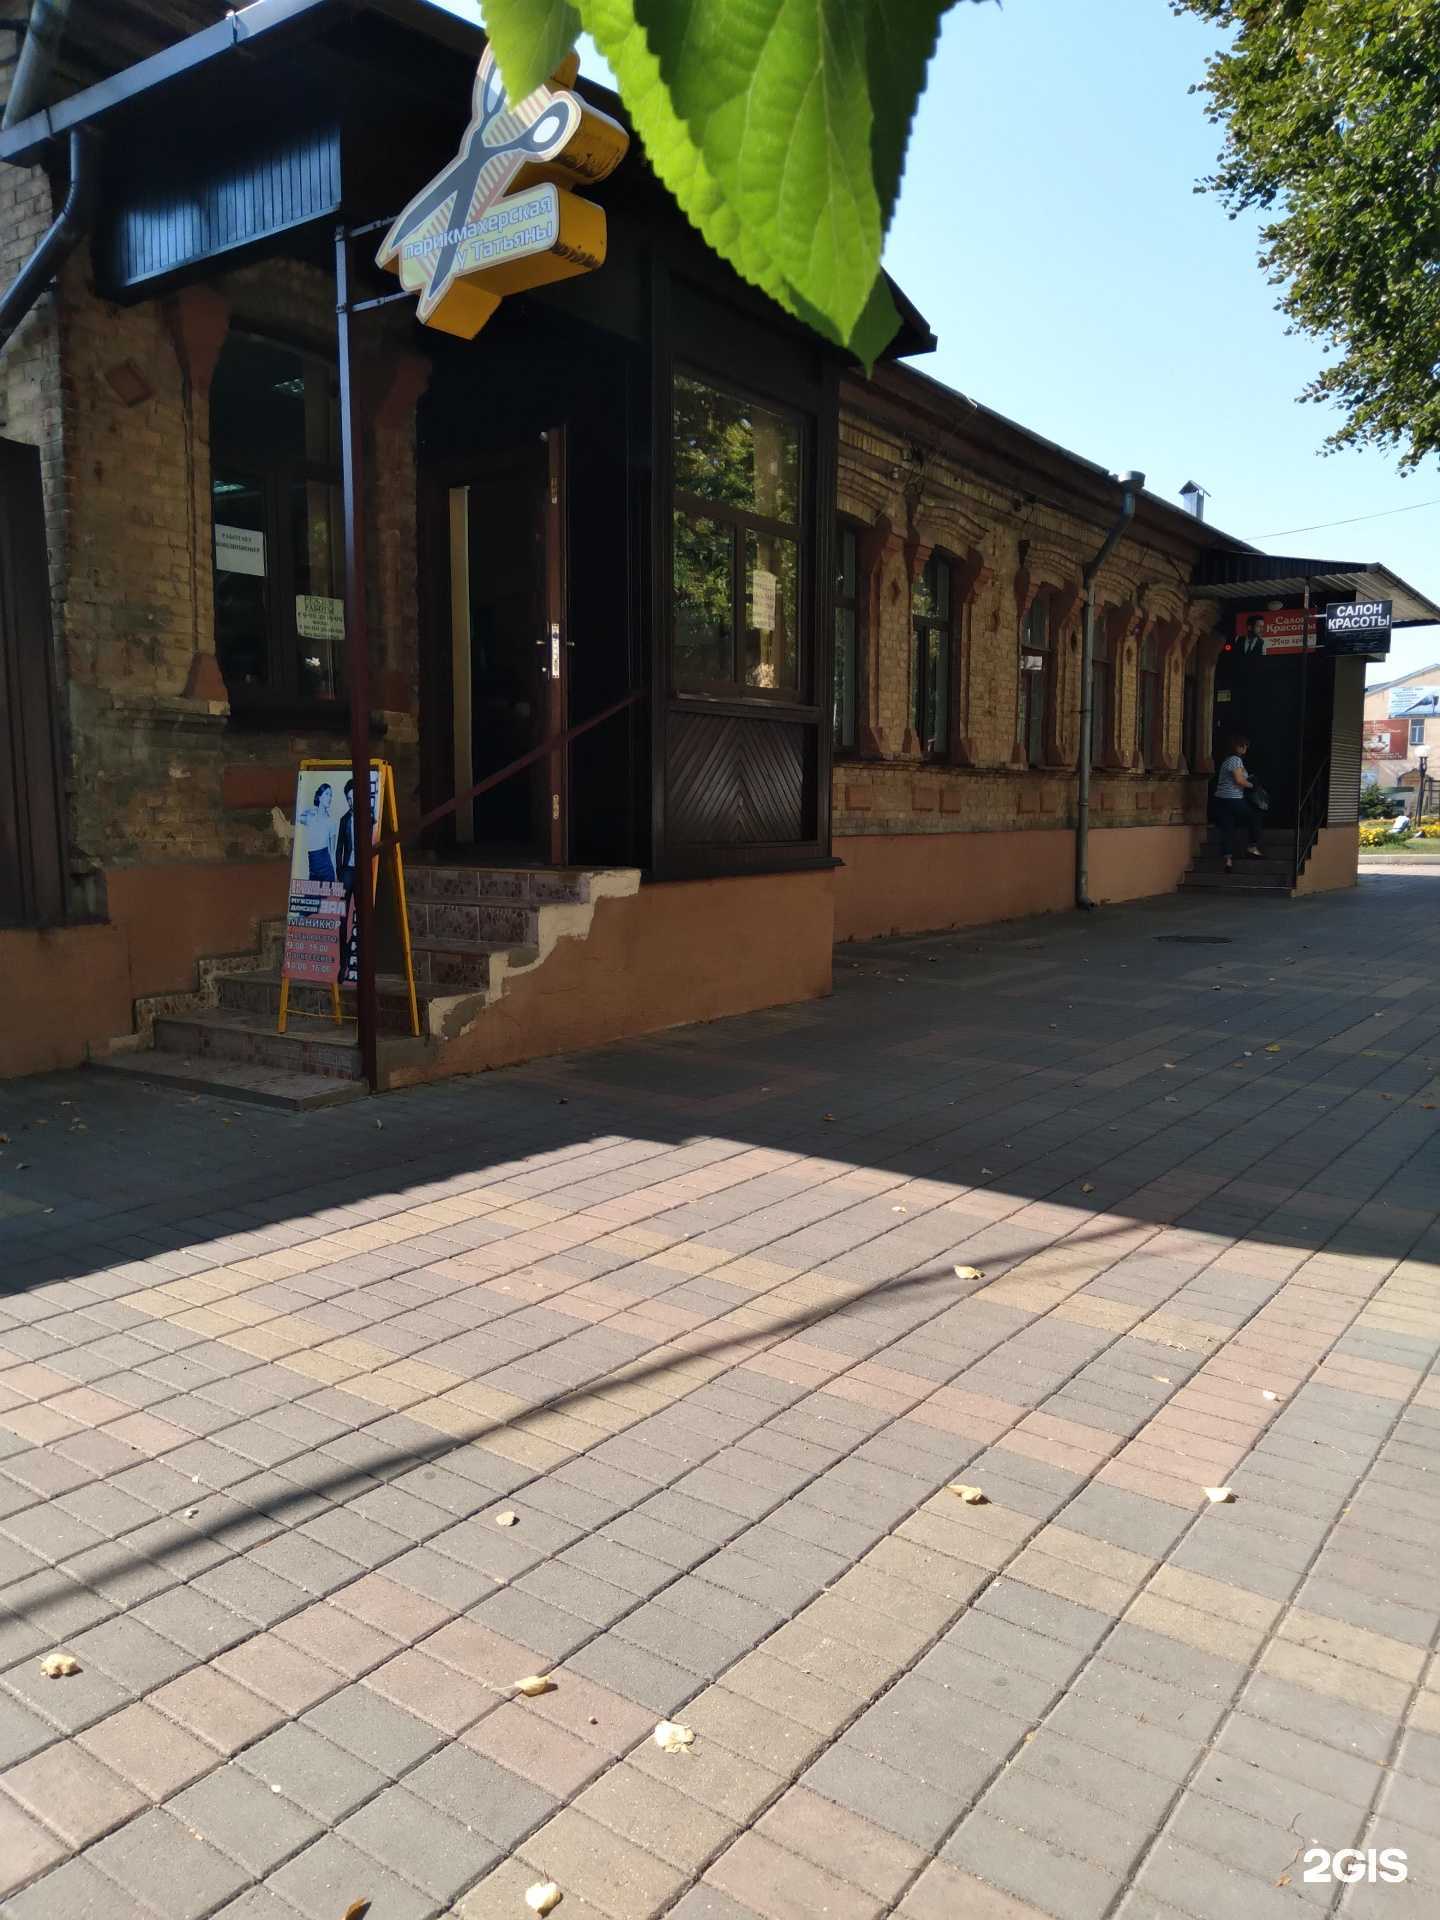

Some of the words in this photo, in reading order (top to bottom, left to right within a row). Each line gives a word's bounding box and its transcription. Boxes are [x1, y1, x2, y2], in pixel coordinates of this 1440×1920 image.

[404, 196, 552, 260] парикмахерская
[472, 221, 552, 261] Татьяны
[1336, 603, 1382, 617] САЛОН
[1328, 614, 1390, 630] КРАСОТЫ
[288, 919, 341, 929] МАНИКЮР
